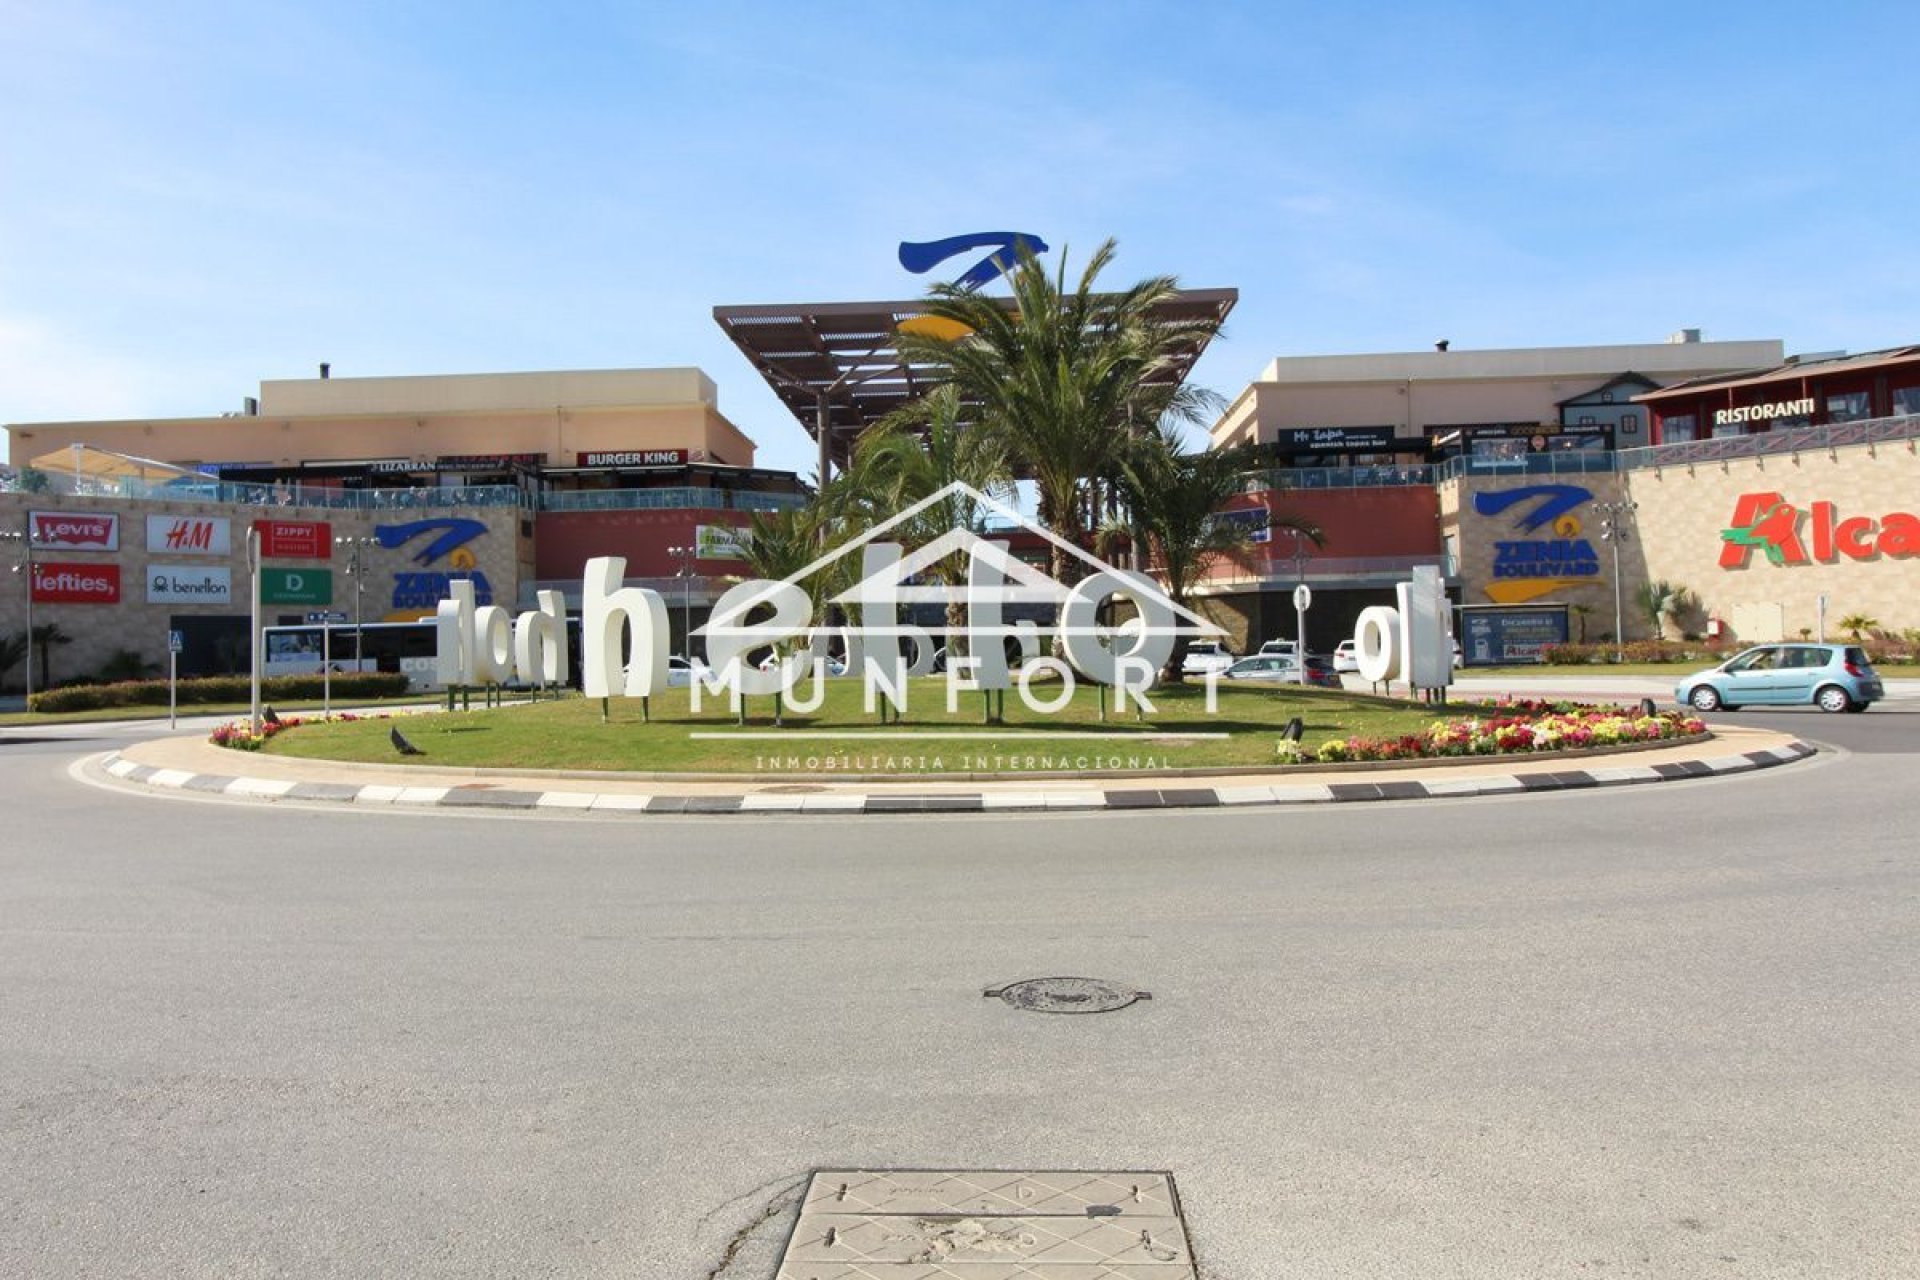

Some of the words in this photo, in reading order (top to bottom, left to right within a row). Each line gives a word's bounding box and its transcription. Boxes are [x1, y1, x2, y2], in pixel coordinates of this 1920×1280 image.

[1715, 398, 1815, 425] RISTORANTI
[588, 452, 642, 466] BURGER
[644, 450, 680, 464] KING
[166, 520, 214, 550] H&M
[276, 527, 313, 537] ZIPPY
[1718, 491, 1920, 569] Alca
[1495, 540, 1599, 563] ZENIA
[1493, 562, 1600, 577] BOULEVARD
